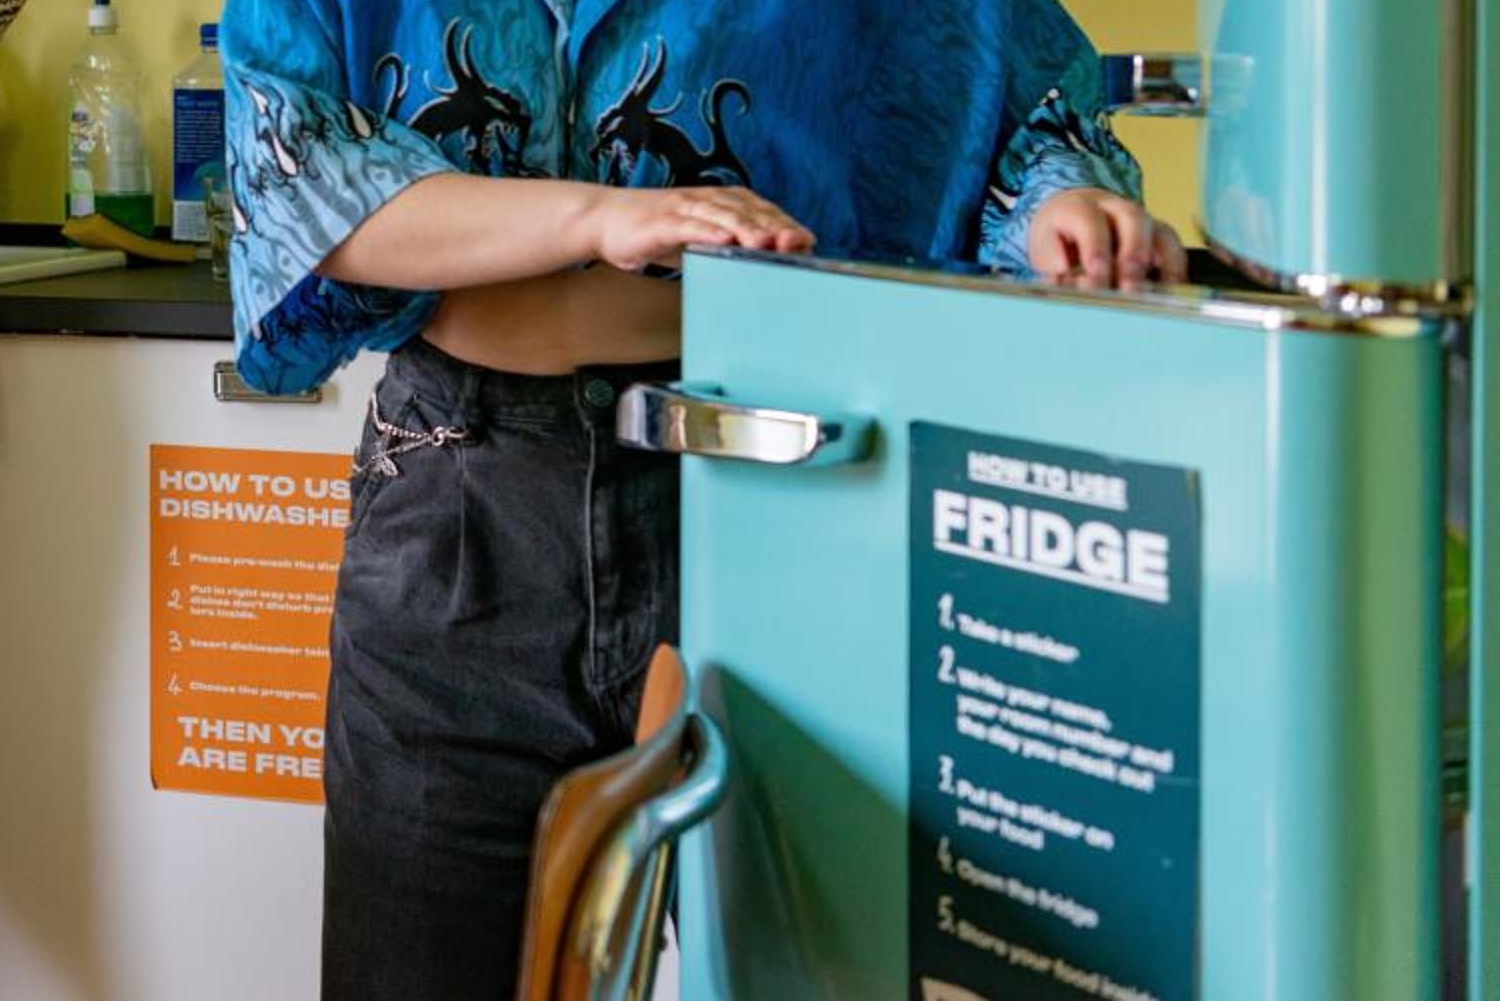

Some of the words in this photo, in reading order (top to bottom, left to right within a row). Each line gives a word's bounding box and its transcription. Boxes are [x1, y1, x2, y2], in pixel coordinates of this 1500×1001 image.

[158, 469, 241, 495] HOW
[248, 473, 297, 497] TO
[304, 477, 351, 500] US
[968, 451, 1028, 485] HOW
[1031, 461, 1067, 491] TO
[1071, 470, 1128, 507] USE
[159, 498, 351, 529] DISHWASHE
[933, 488, 1170, 597] FRIDGE
[956, 666, 1006, 699] Write
[1007, 685, 1051, 713] your
[177, 716, 271, 744] THEN
[279, 726, 325, 749] YO
[177, 746, 248, 772] ARE
[256, 753, 324, 779] FRE
[956, 779, 988, 806] Put
[989, 790, 1020, 818] the
[1020, 803, 1085, 840] sticker
[956, 806, 999, 834] your
[999, 818, 1045, 851] food
[956, 858, 1006, 888] Open
[1007, 878, 1038, 906] the
[1038, 888, 1099, 930] fridge
[1008, 945, 1052, 974] your
[1053, 957, 1100, 994] food
